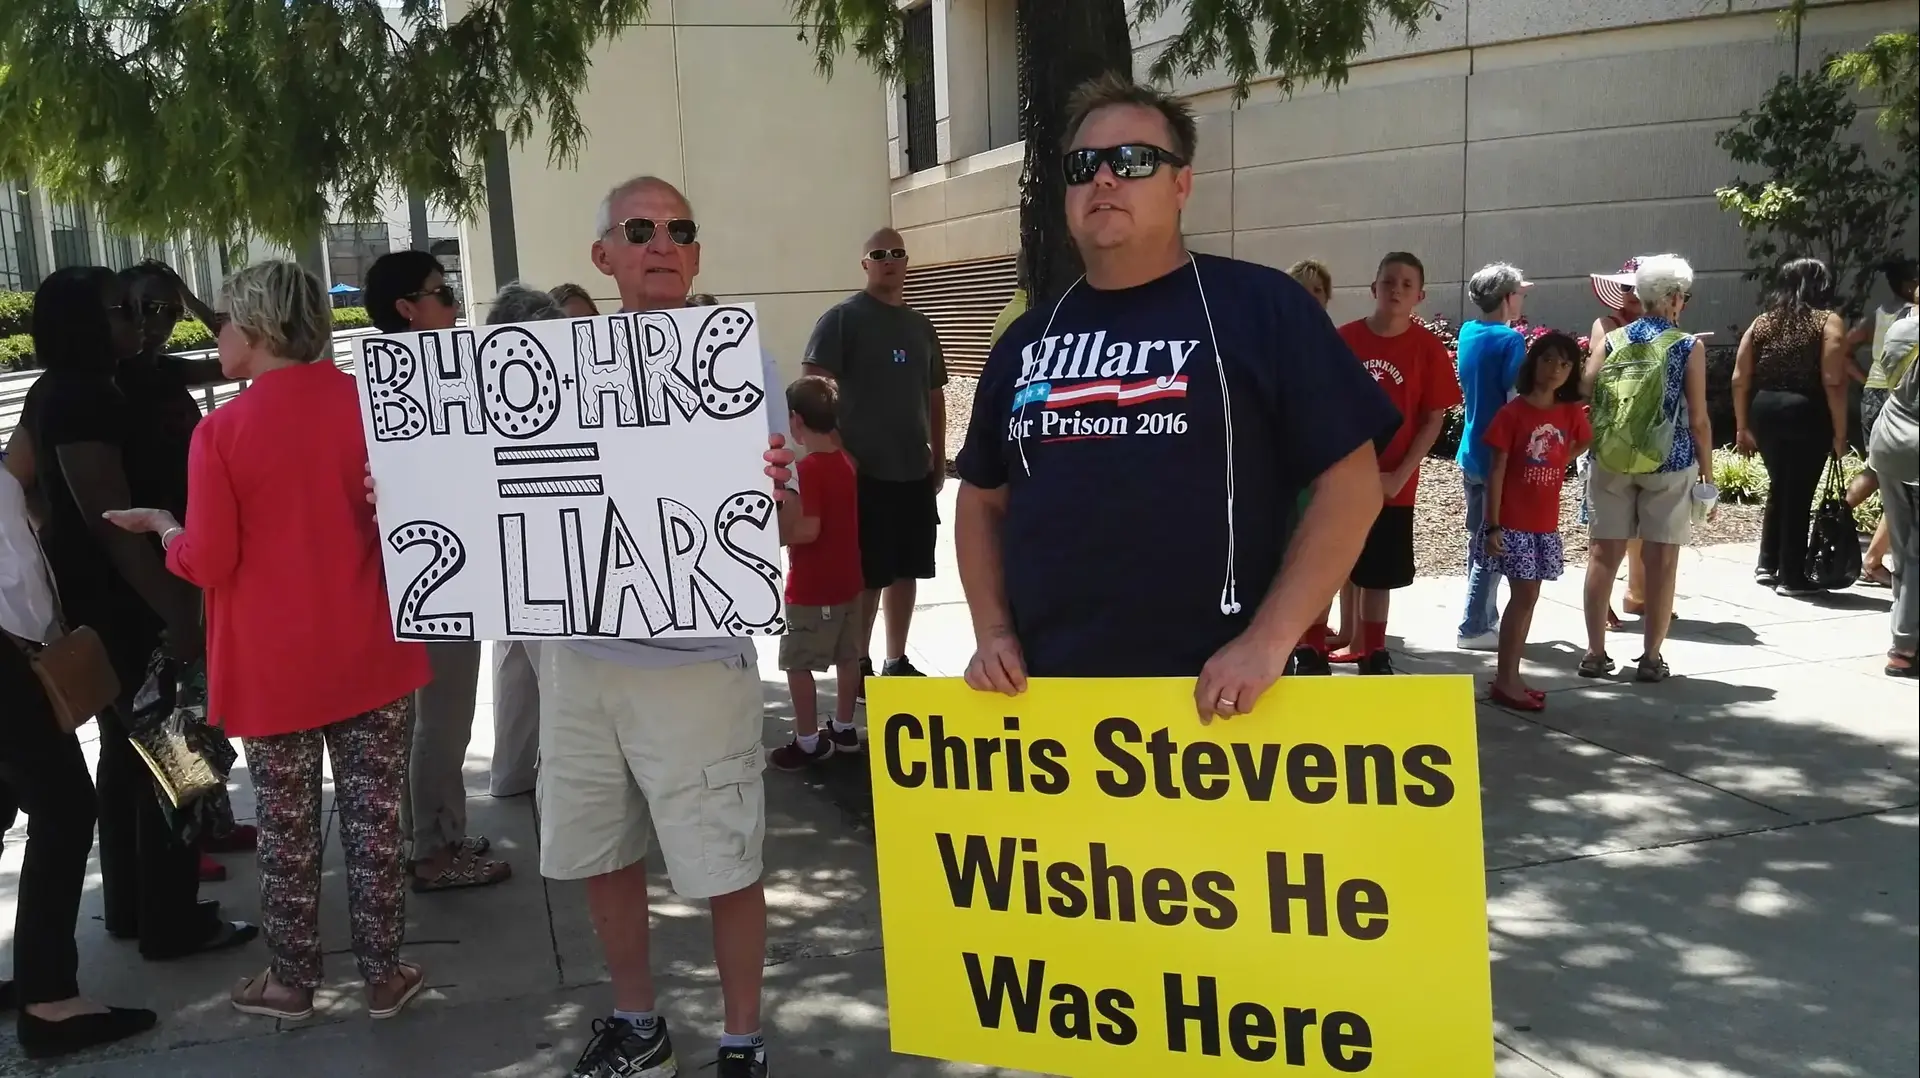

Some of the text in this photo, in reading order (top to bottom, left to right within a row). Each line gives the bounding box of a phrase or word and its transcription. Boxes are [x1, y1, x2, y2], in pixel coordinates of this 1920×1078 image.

[1014, 330, 1200, 388] Hillary
[1362, 359, 1404, 385] VENKNOB
[1007, 410, 1188, 441] for Prison 2016
[388, 490, 788, 640] 2 LIARS
[884, 712, 1455, 807] Chris Stevens
[935, 832, 1389, 940] Wishes He
[962, 952, 1373, 1073] Was Here
